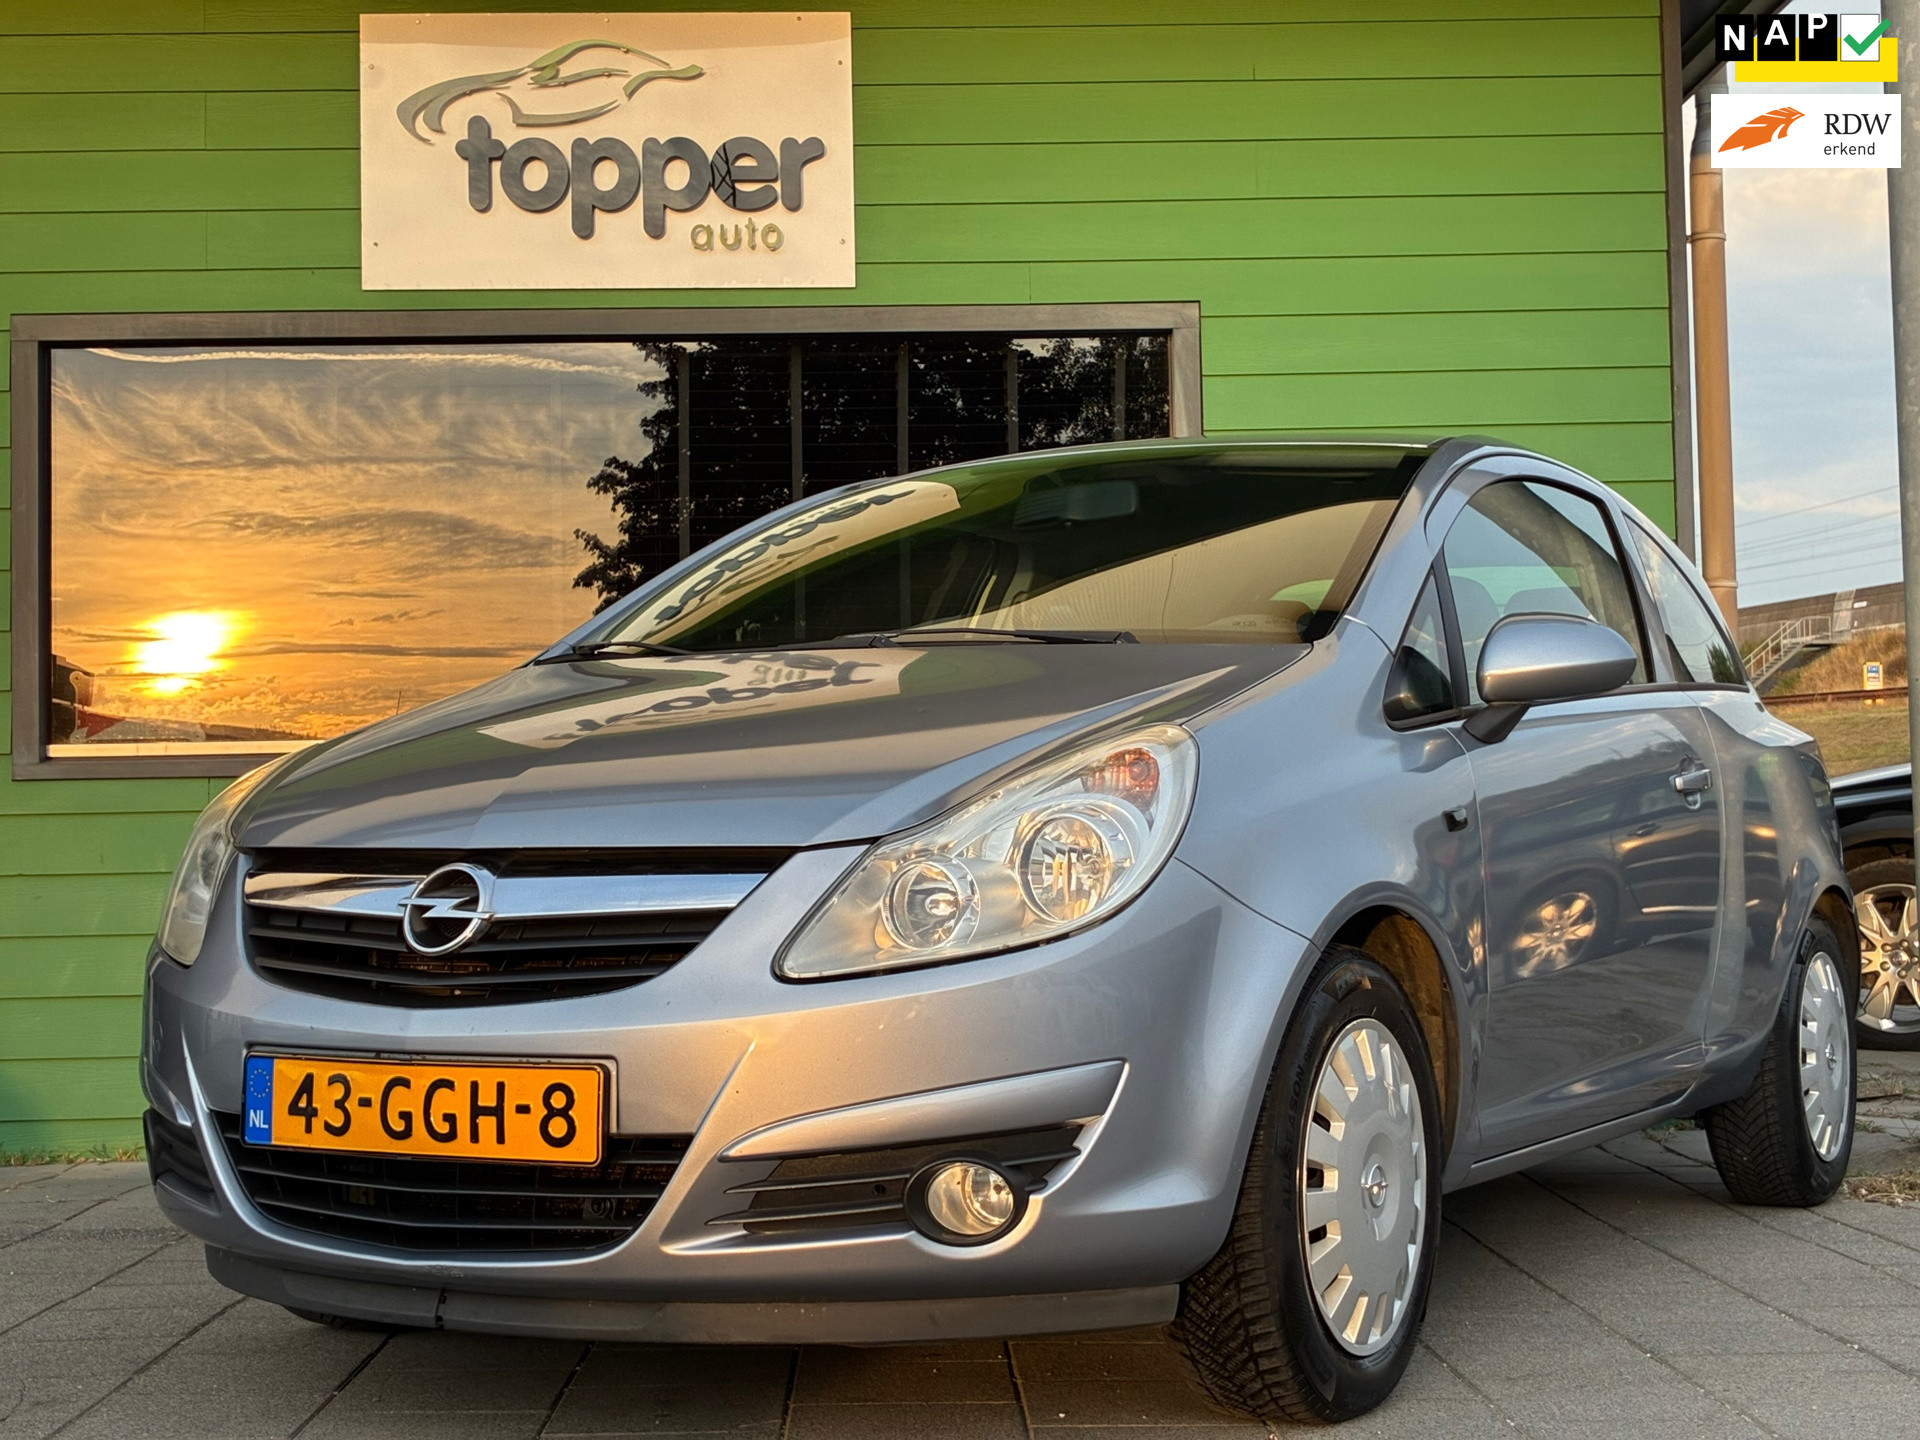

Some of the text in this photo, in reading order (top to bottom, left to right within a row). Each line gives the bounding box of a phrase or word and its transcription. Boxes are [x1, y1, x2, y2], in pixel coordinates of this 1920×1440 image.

[455, 115, 826, 240] topper
[690, 217, 784, 251] auto
[248, 1108, 269, 1130] NL
[287, 1072, 578, 1149] 43-GGH-8
